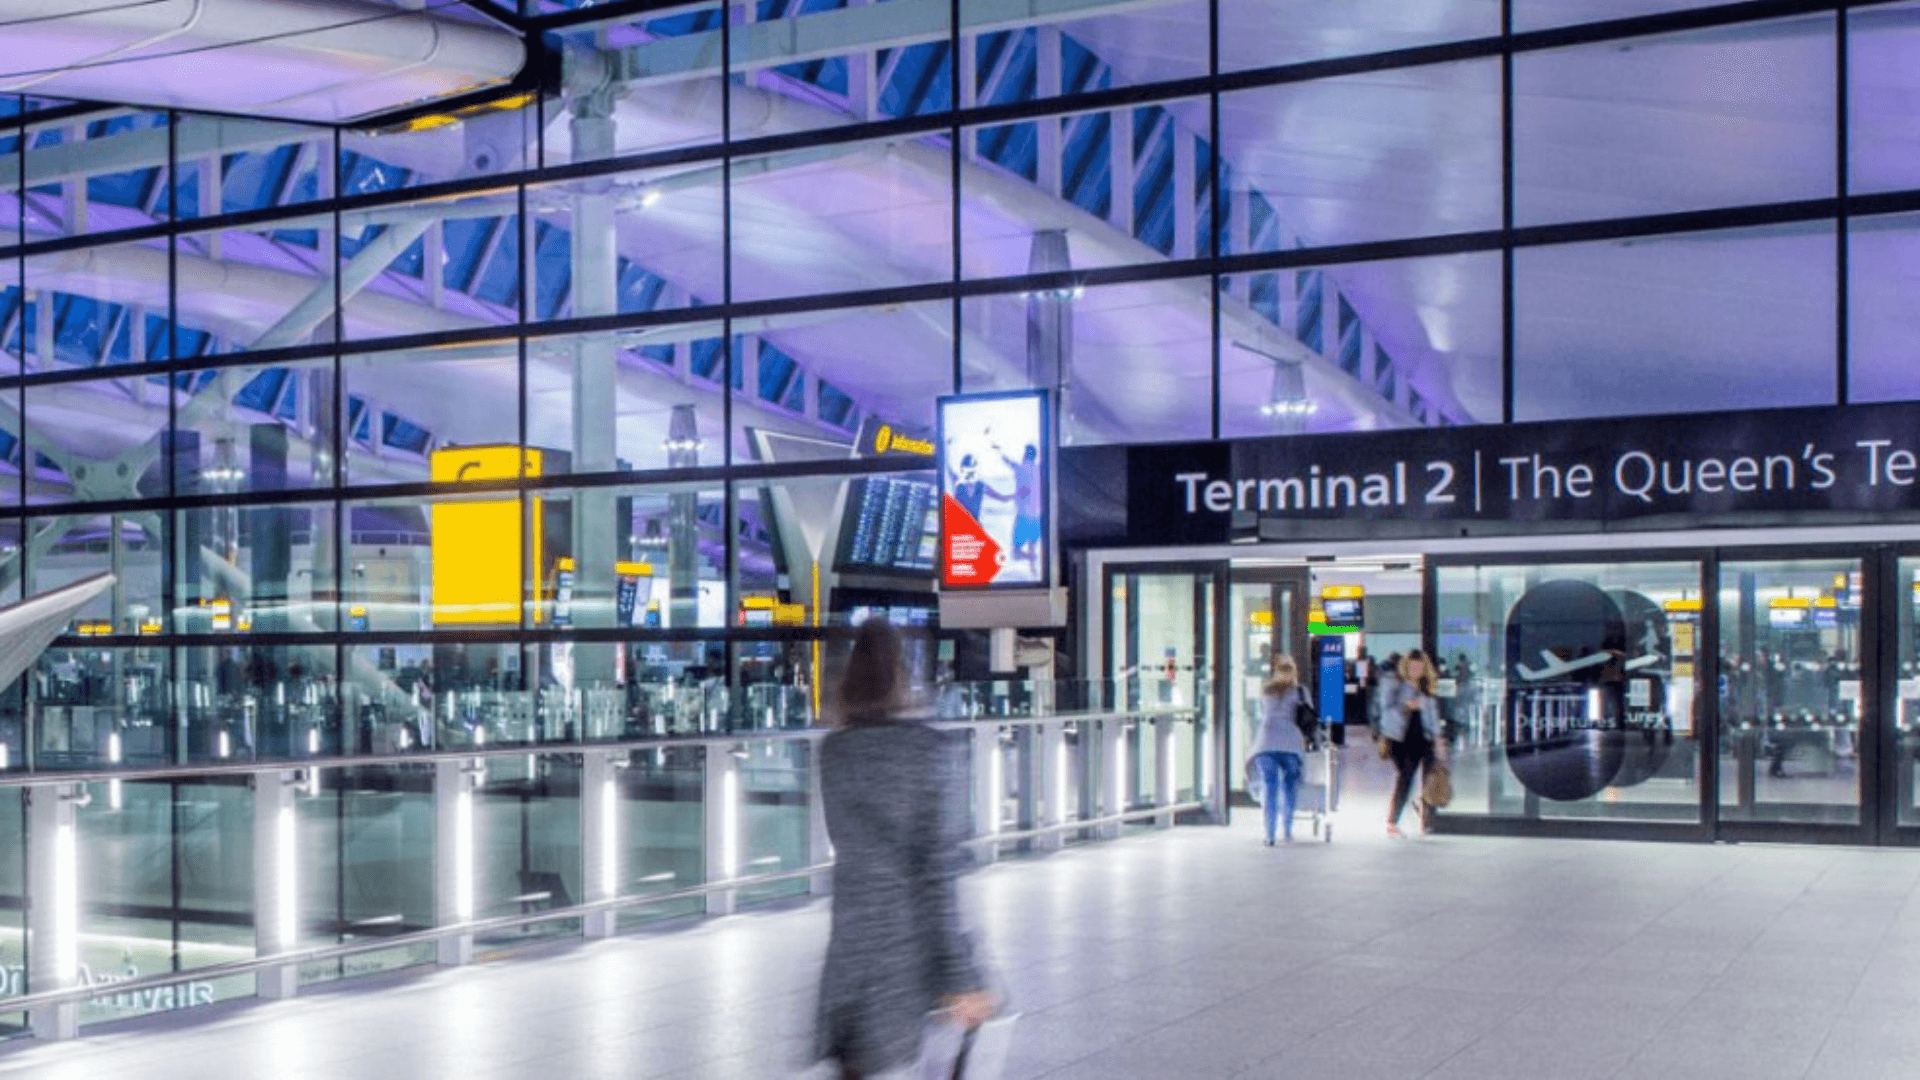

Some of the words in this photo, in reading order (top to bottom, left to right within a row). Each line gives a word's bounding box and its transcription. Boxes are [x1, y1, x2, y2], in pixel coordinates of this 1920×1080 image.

[1175, 461, 1406, 512] Terminal
[1424, 461, 1456, 504] 2
[1499, 453, 1594, 500] The
[1614, 444, 1836, 502] Queen's
[1855, 439, 1917, 486] Te
